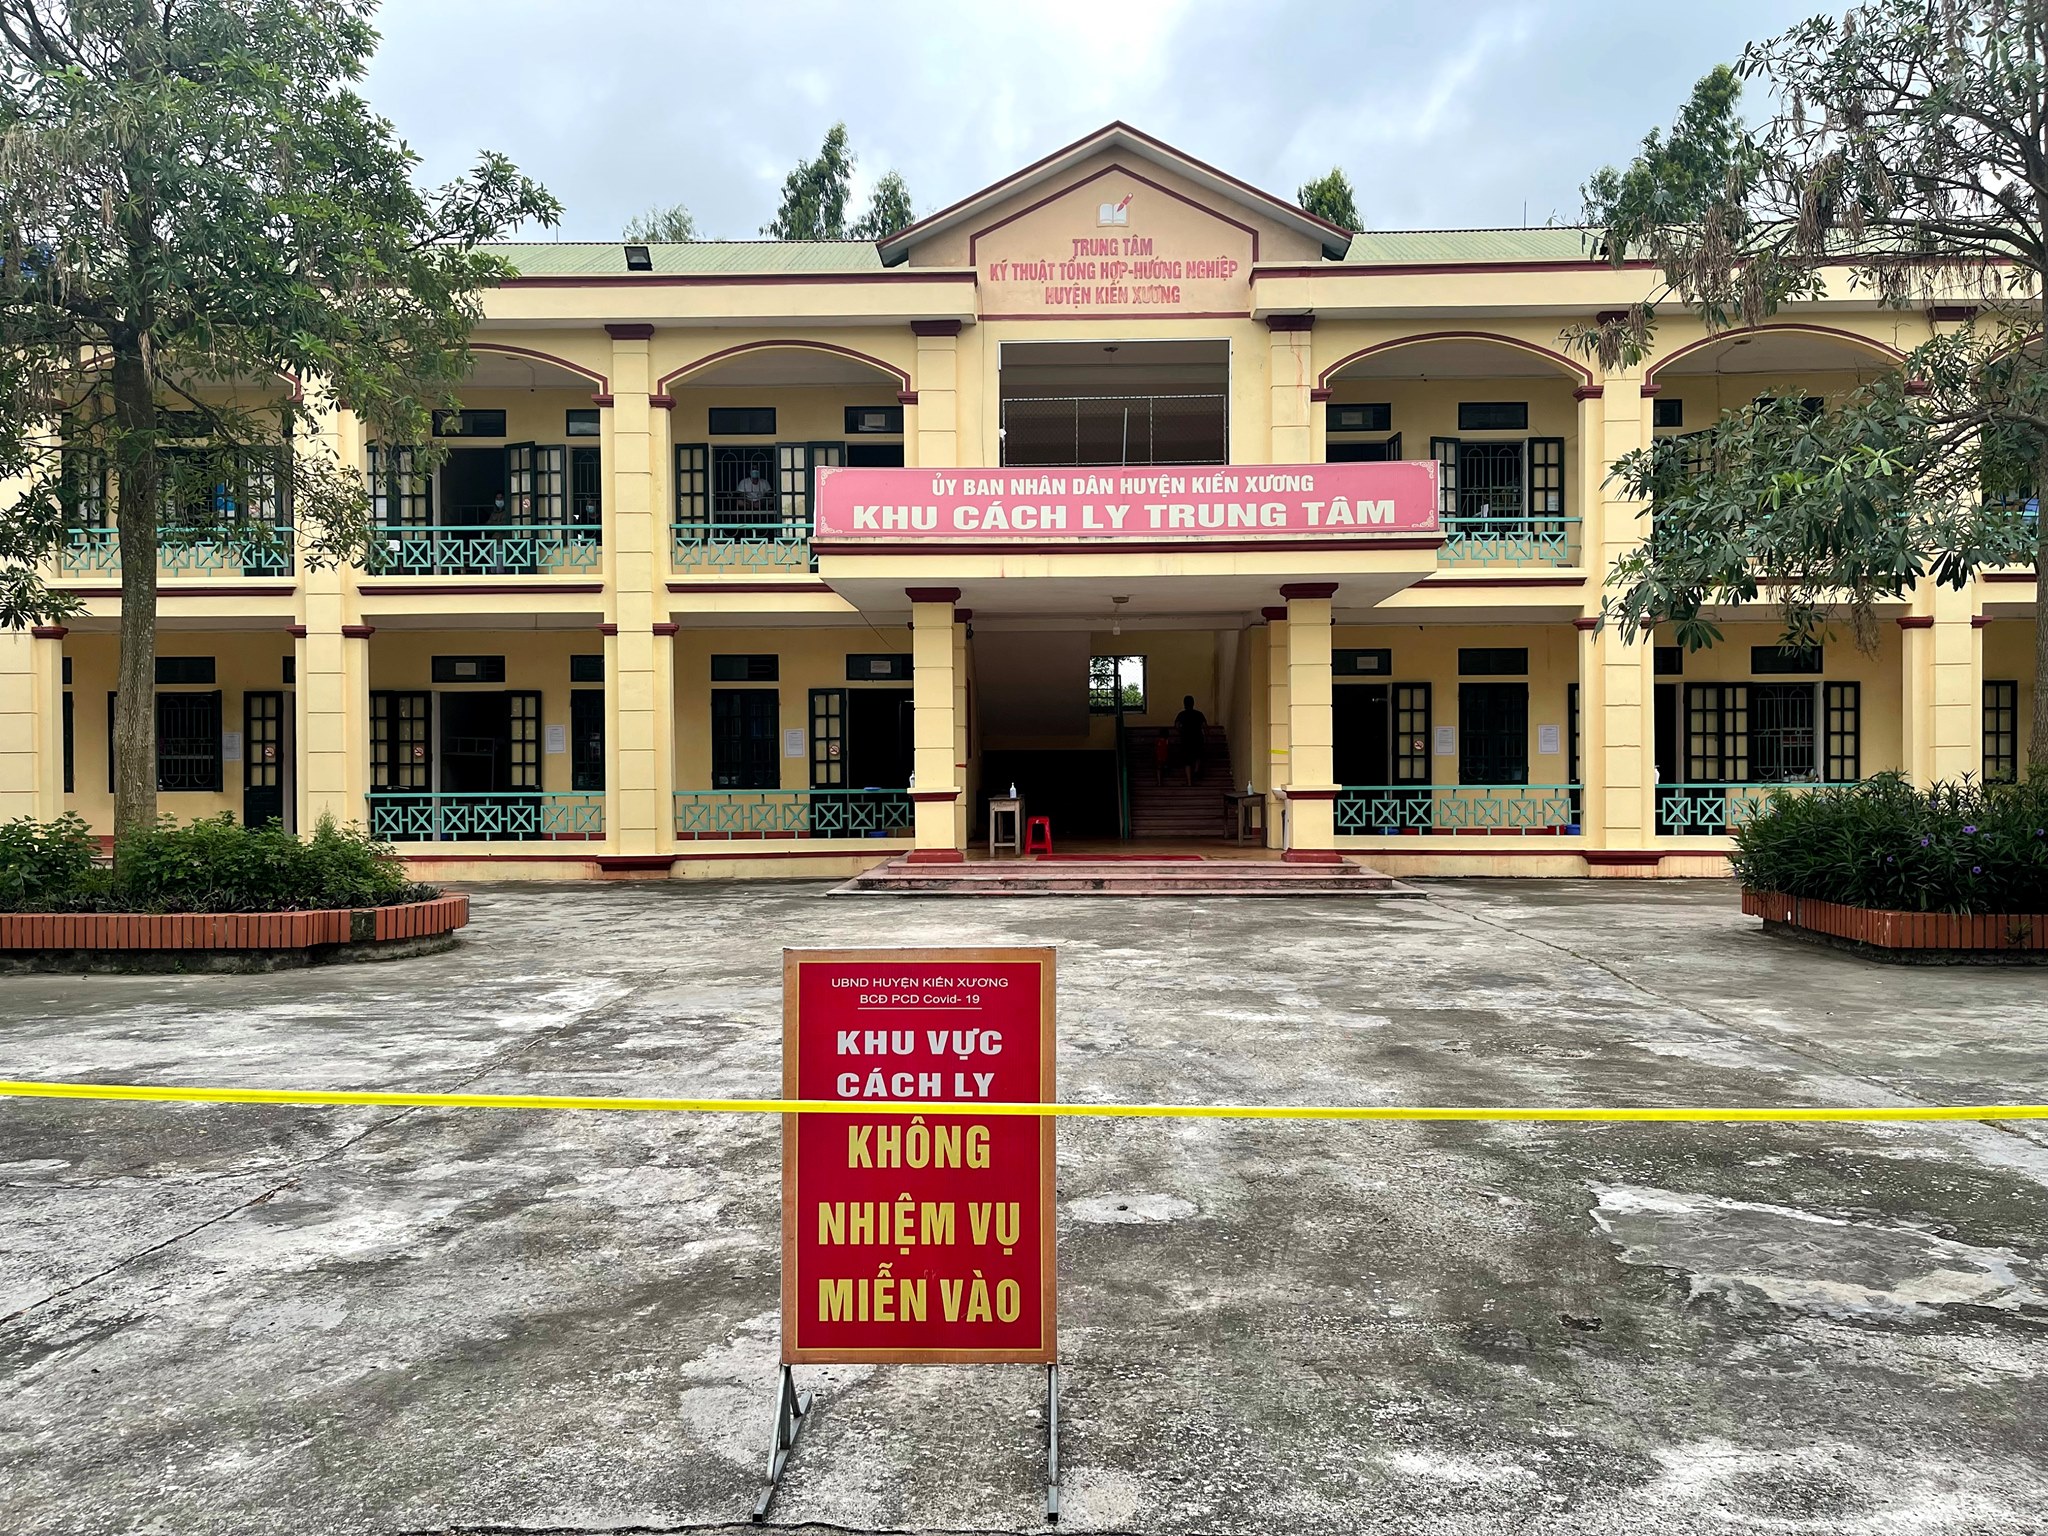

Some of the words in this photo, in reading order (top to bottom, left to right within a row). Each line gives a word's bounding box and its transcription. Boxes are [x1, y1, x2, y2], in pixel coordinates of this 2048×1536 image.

[1072, 238, 1119, 256] TRUNG
[1122, 233, 1153, 256] TÂM
[1012, 259, 1055, 284] THUẬT
[1059, 256, 1096, 280] TỔNG
[1045, 282, 1091, 309] HUYỆN
[1095, 280, 1129, 304] KIẾN
[1132, 284, 1181, 304] XƯƠNG
[932, 472, 957, 496] ỦY
[963, 479, 1004, 496] BAN
[1010, 475, 1066, 496] NHÂN
[1072, 475, 1114, 495] DÂN
[1120, 474, 1186, 498] HUYỆN
[1192, 471, 1239, 493] KIẾN
[1245, 474, 1314, 493] XƯƠNG
[853, 506, 938, 530] KHU
[953, 501, 1067, 530] CÁCH
[1082, 505, 1131, 529] LY
[1144, 503, 1287, 529] TRUNG
[1302, 496, 1395, 526] TÂM
[831, 978, 869, 988] UBND
[872, 977, 919, 989] HUYỆN
[957, 978, 1009, 988] XƯƠNG
[860, 994, 888, 1004] BCĐ
[891, 994, 920, 1004] PCD
[923, 994, 962, 1004] Covid-
[965, 994, 980, 1004] 19
[837, 1030, 915, 1055] KHU
[926, 1028, 1003, 1060] VỰC
[836, 1067, 942, 1097] CÁCH
[954, 1072, 995, 1097] LY
[848, 1116, 991, 1169] KHÔNG
[818, 1192, 956, 1256] NHIỆM
[968, 1202, 1020, 1256] VỤ
[818, 1262, 928, 1323] MIỄN
[939, 1269, 1021, 1323] VÀO
